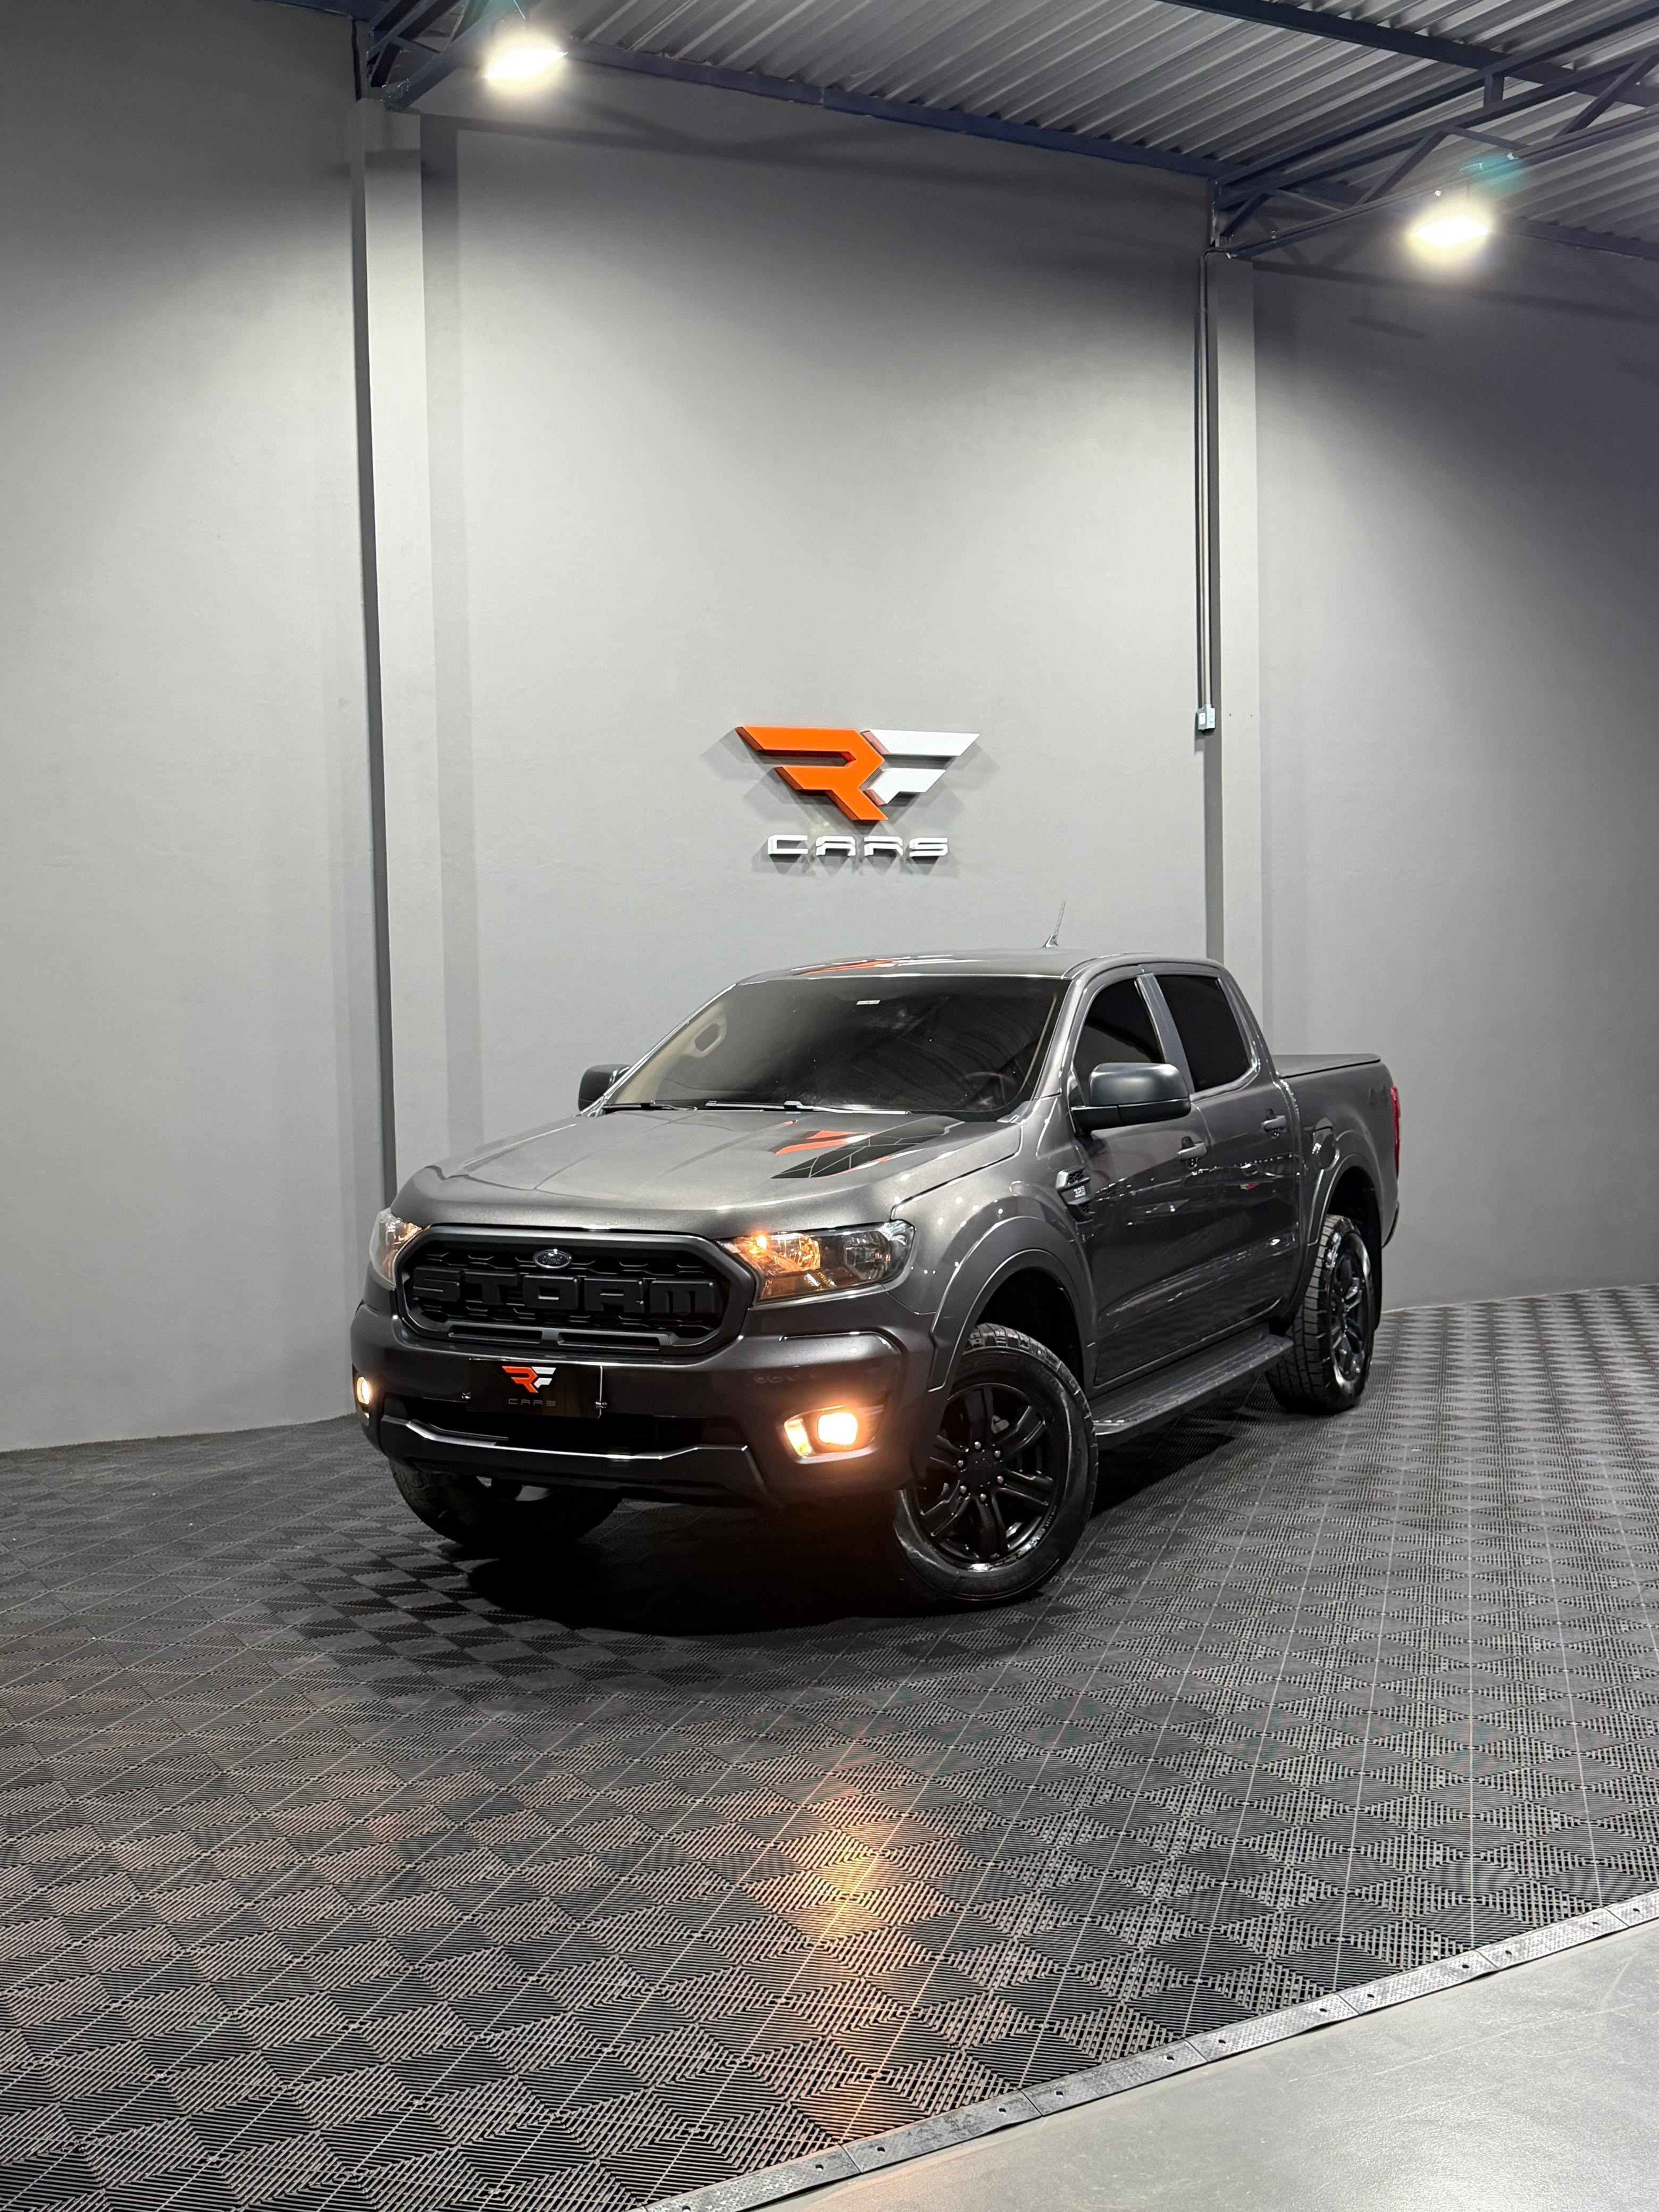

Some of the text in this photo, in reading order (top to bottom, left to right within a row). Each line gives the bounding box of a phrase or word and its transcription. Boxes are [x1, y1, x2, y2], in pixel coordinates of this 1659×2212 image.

[767, 835, 948, 857] CARS
[412, 1266, 721, 1314] STORM
[507, 1398, 556, 1407] CARS
